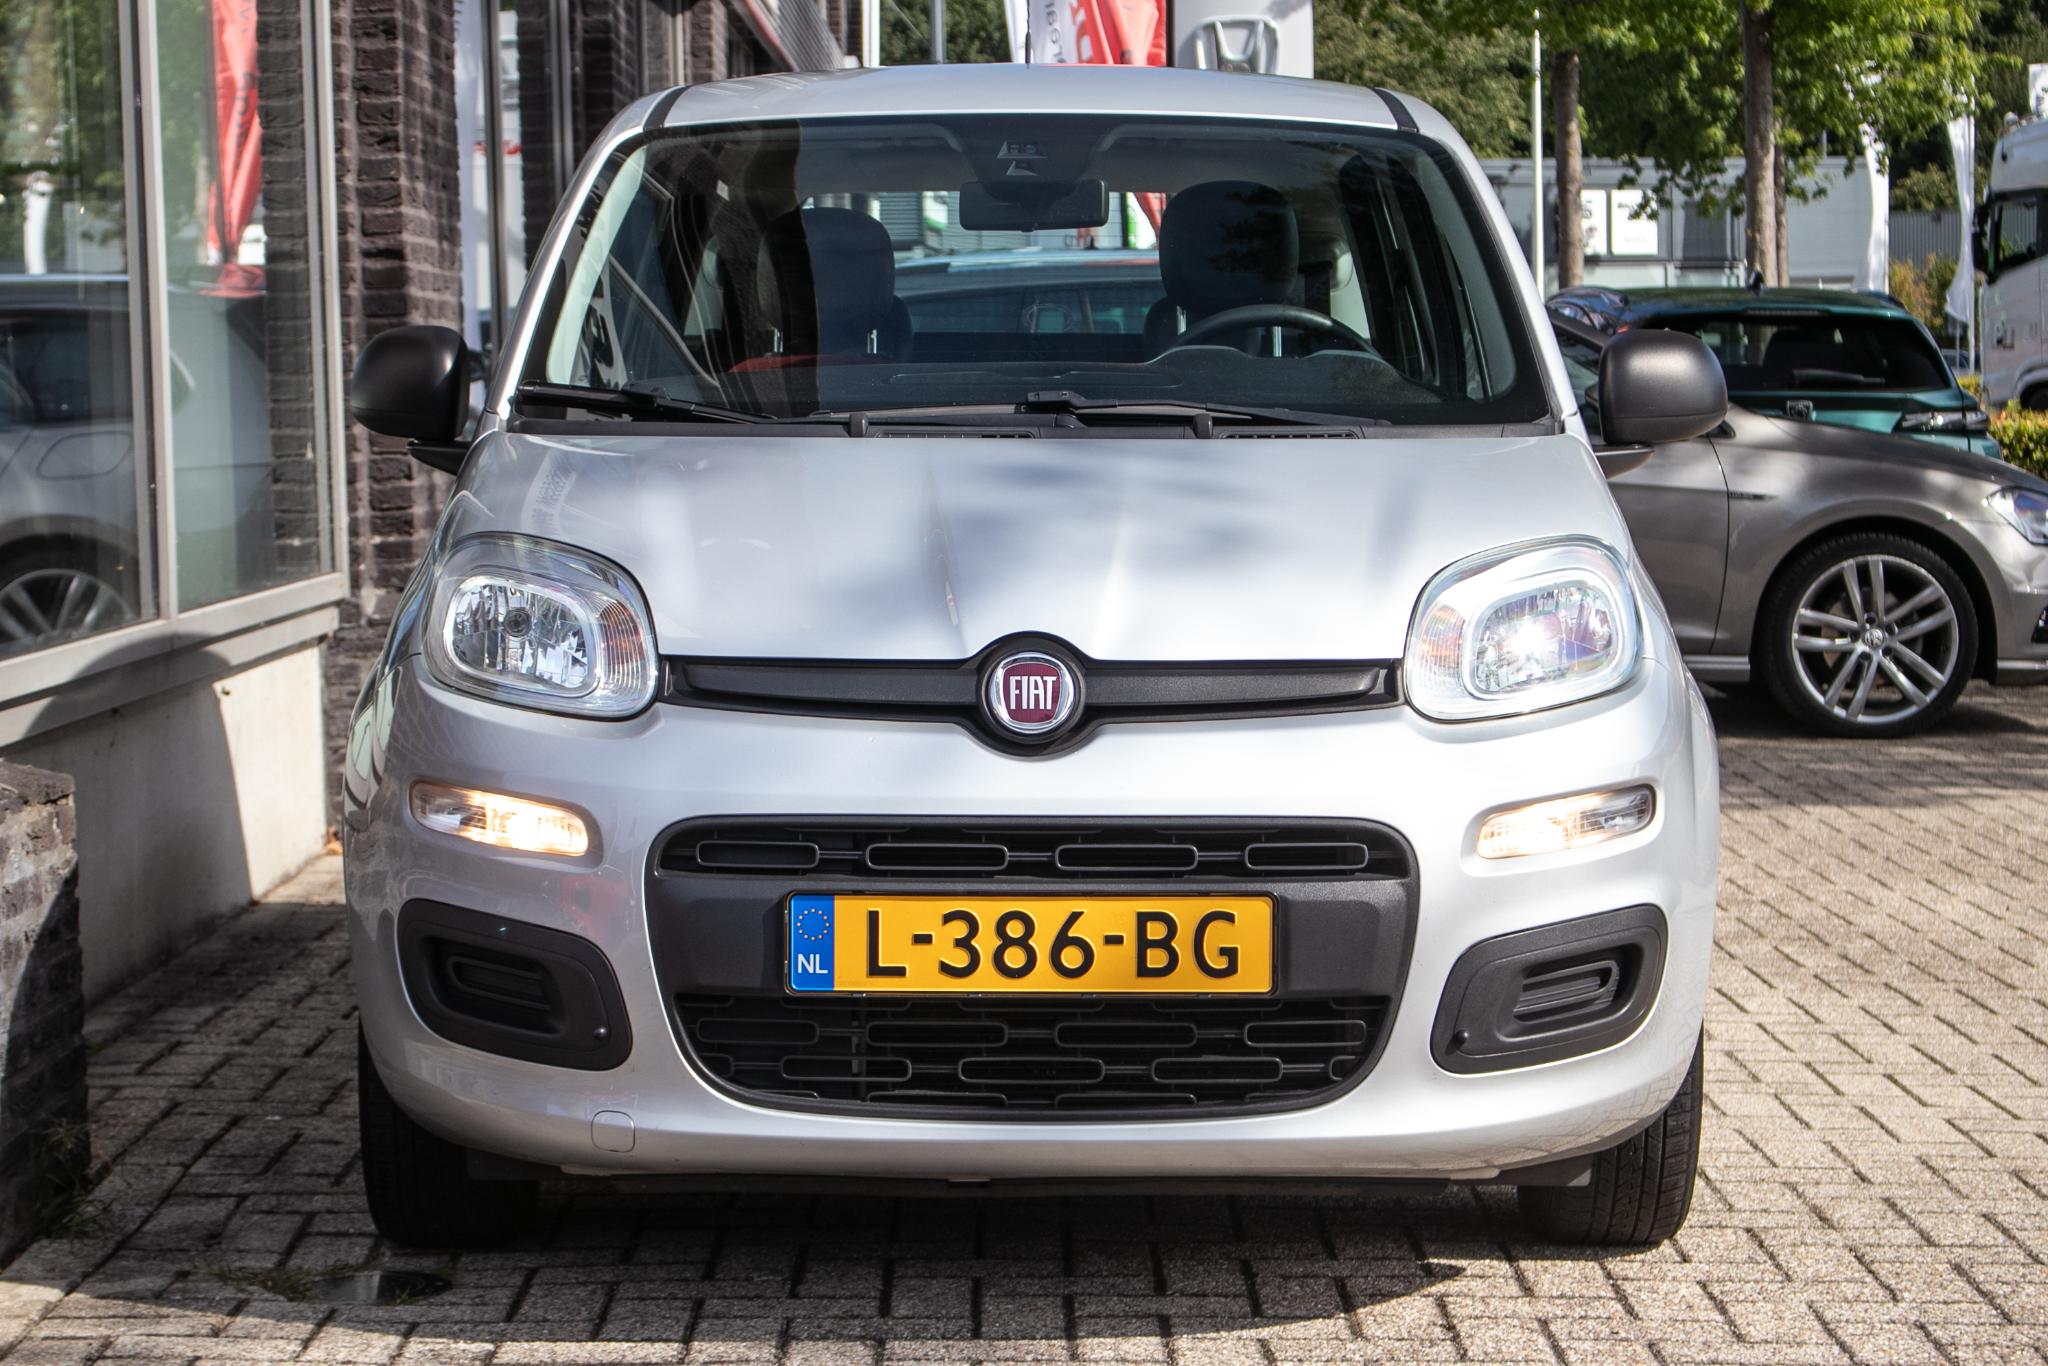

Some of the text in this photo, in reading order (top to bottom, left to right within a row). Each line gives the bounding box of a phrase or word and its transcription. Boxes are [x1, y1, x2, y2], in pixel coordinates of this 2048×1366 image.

[1009, 675, 1057, 710] FIAT
[867, 910, 1240, 979] L-386-BG
[797, 953, 828, 974] NL
